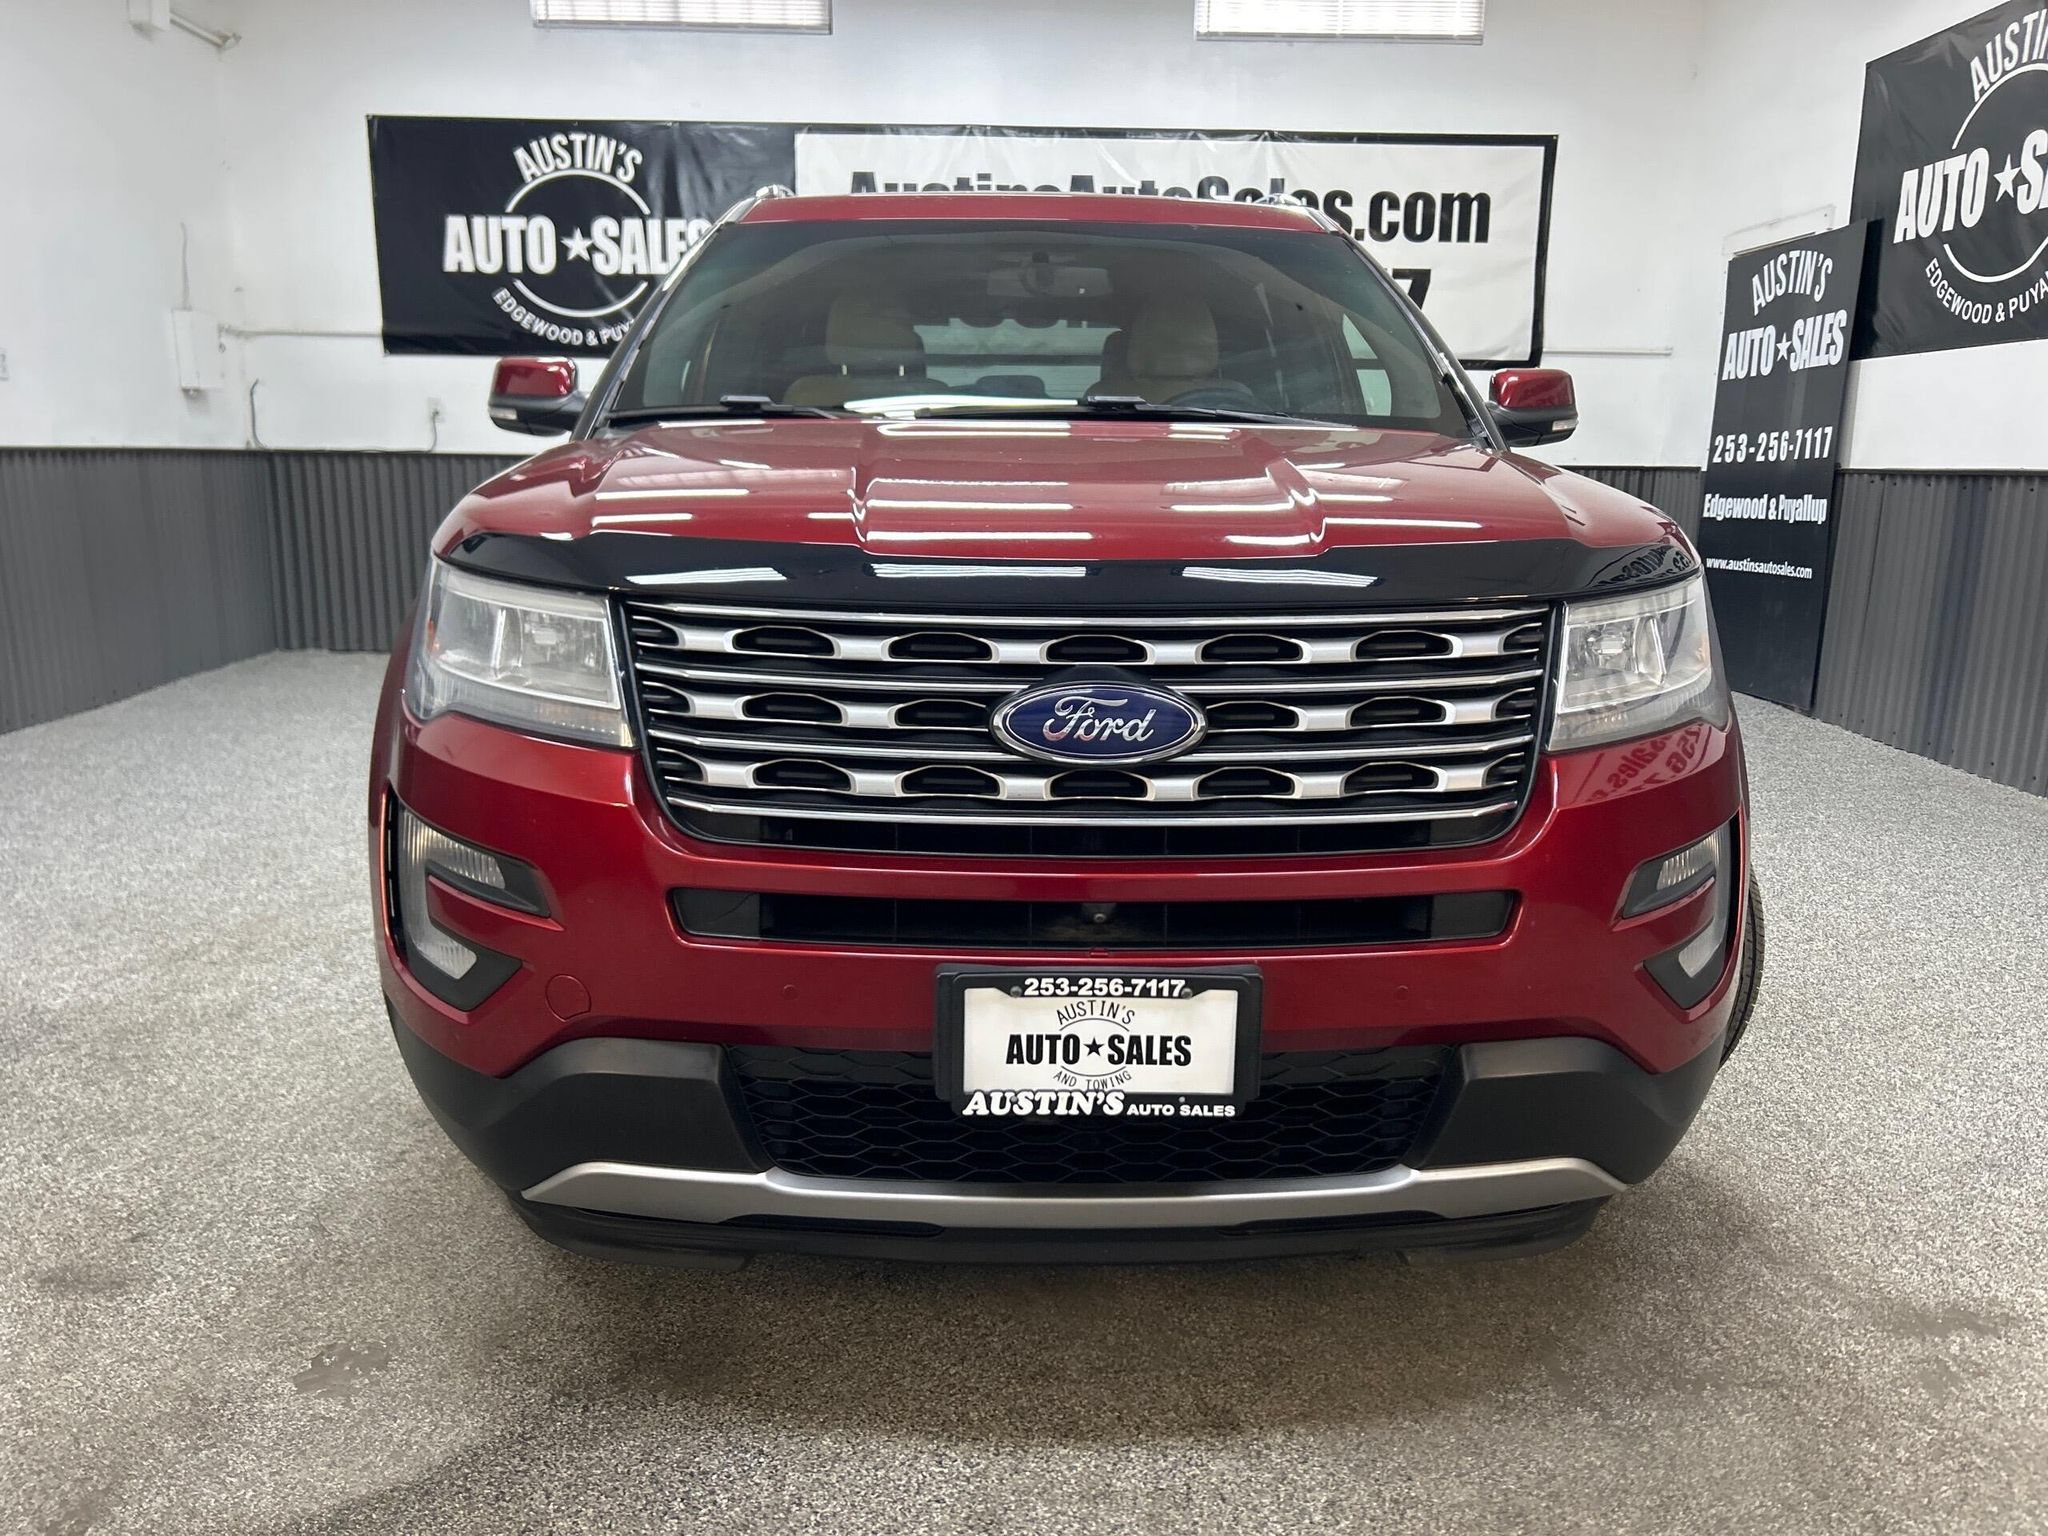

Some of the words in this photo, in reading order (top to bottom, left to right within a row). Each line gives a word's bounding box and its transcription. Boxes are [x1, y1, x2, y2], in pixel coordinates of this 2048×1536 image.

[513, 133, 643, 184] AUSTIN'S
[1893, 147, 1990, 244] AUTO
[443, 215, 557, 274] AUTO
[1752, 249, 1833, 316] AUSTIN'S
[1925, 257, 1992, 324] EDGEWOOD
[1995, 302, 2006, 323] &
[493, 287, 584, 345] EDGEWOOD
[585, 329, 599, 346] &
[1722, 325, 1776, 381] AUTO
[1790, 309, 1847, 372] SALES
[1713, 426, 1833, 464] 253-256-7117
[1703, 494, 1768, 521] Edgewood
[1768, 497, 1777, 520] &
[1778, 494, 1827, 524] Puyallup
[1706, 558, 1812, 579] www.austinsautosales.com
[1042, 696, 1156, 741] Ford
[1024, 978, 1186, 997] 253-256-7117
[1056, 1000, 1135, 1025] AUSTIN'S
[1006, 1034, 1080, 1065] AUTO
[1107, 1034, 1191, 1066] SALES
[1052, 1069, 1077, 1087] AND
[1086, 1070, 1132, 1091] TOWING
[962, 1090, 1125, 1116] AUSTIN'S
[1126, 1104, 1175, 1116] AUTO
[1179, 1104, 1236, 1118] SALES
